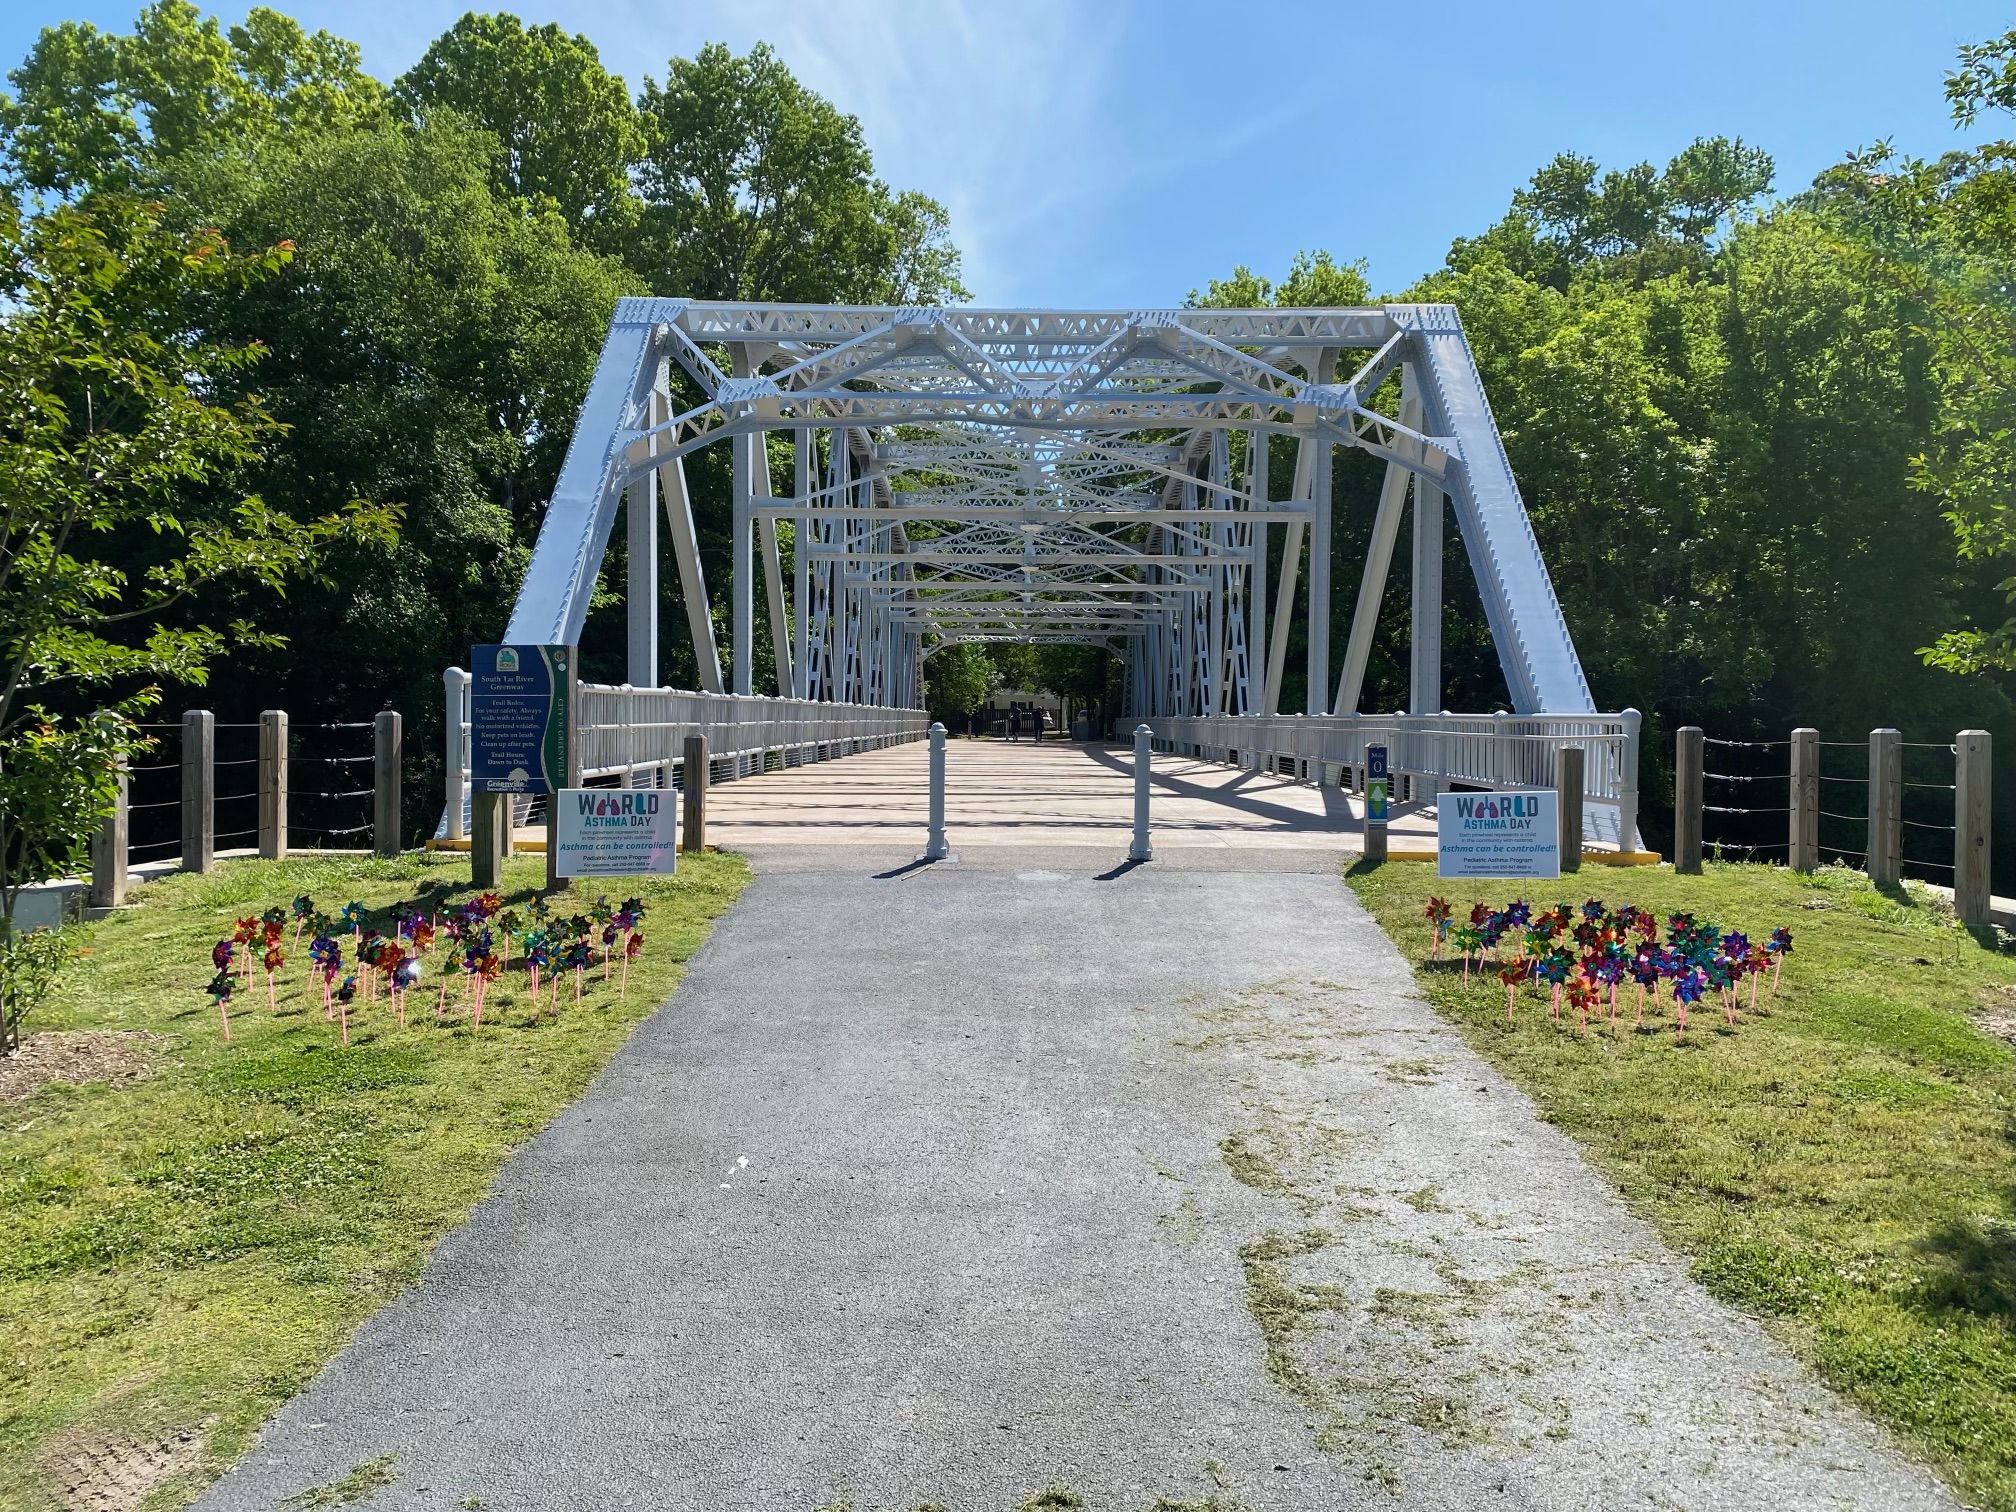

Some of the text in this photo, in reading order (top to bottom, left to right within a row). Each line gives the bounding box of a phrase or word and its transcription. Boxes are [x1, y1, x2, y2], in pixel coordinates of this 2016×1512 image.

[1374, 761, 1382, 772] 0
[578, 793, 658, 815] WORLD
[1456, 796, 1539, 818] WORLD
[585, 816, 652, 827] ASTHMA DAY
[1464, 818, 1531, 829] ASTHMA DAY
